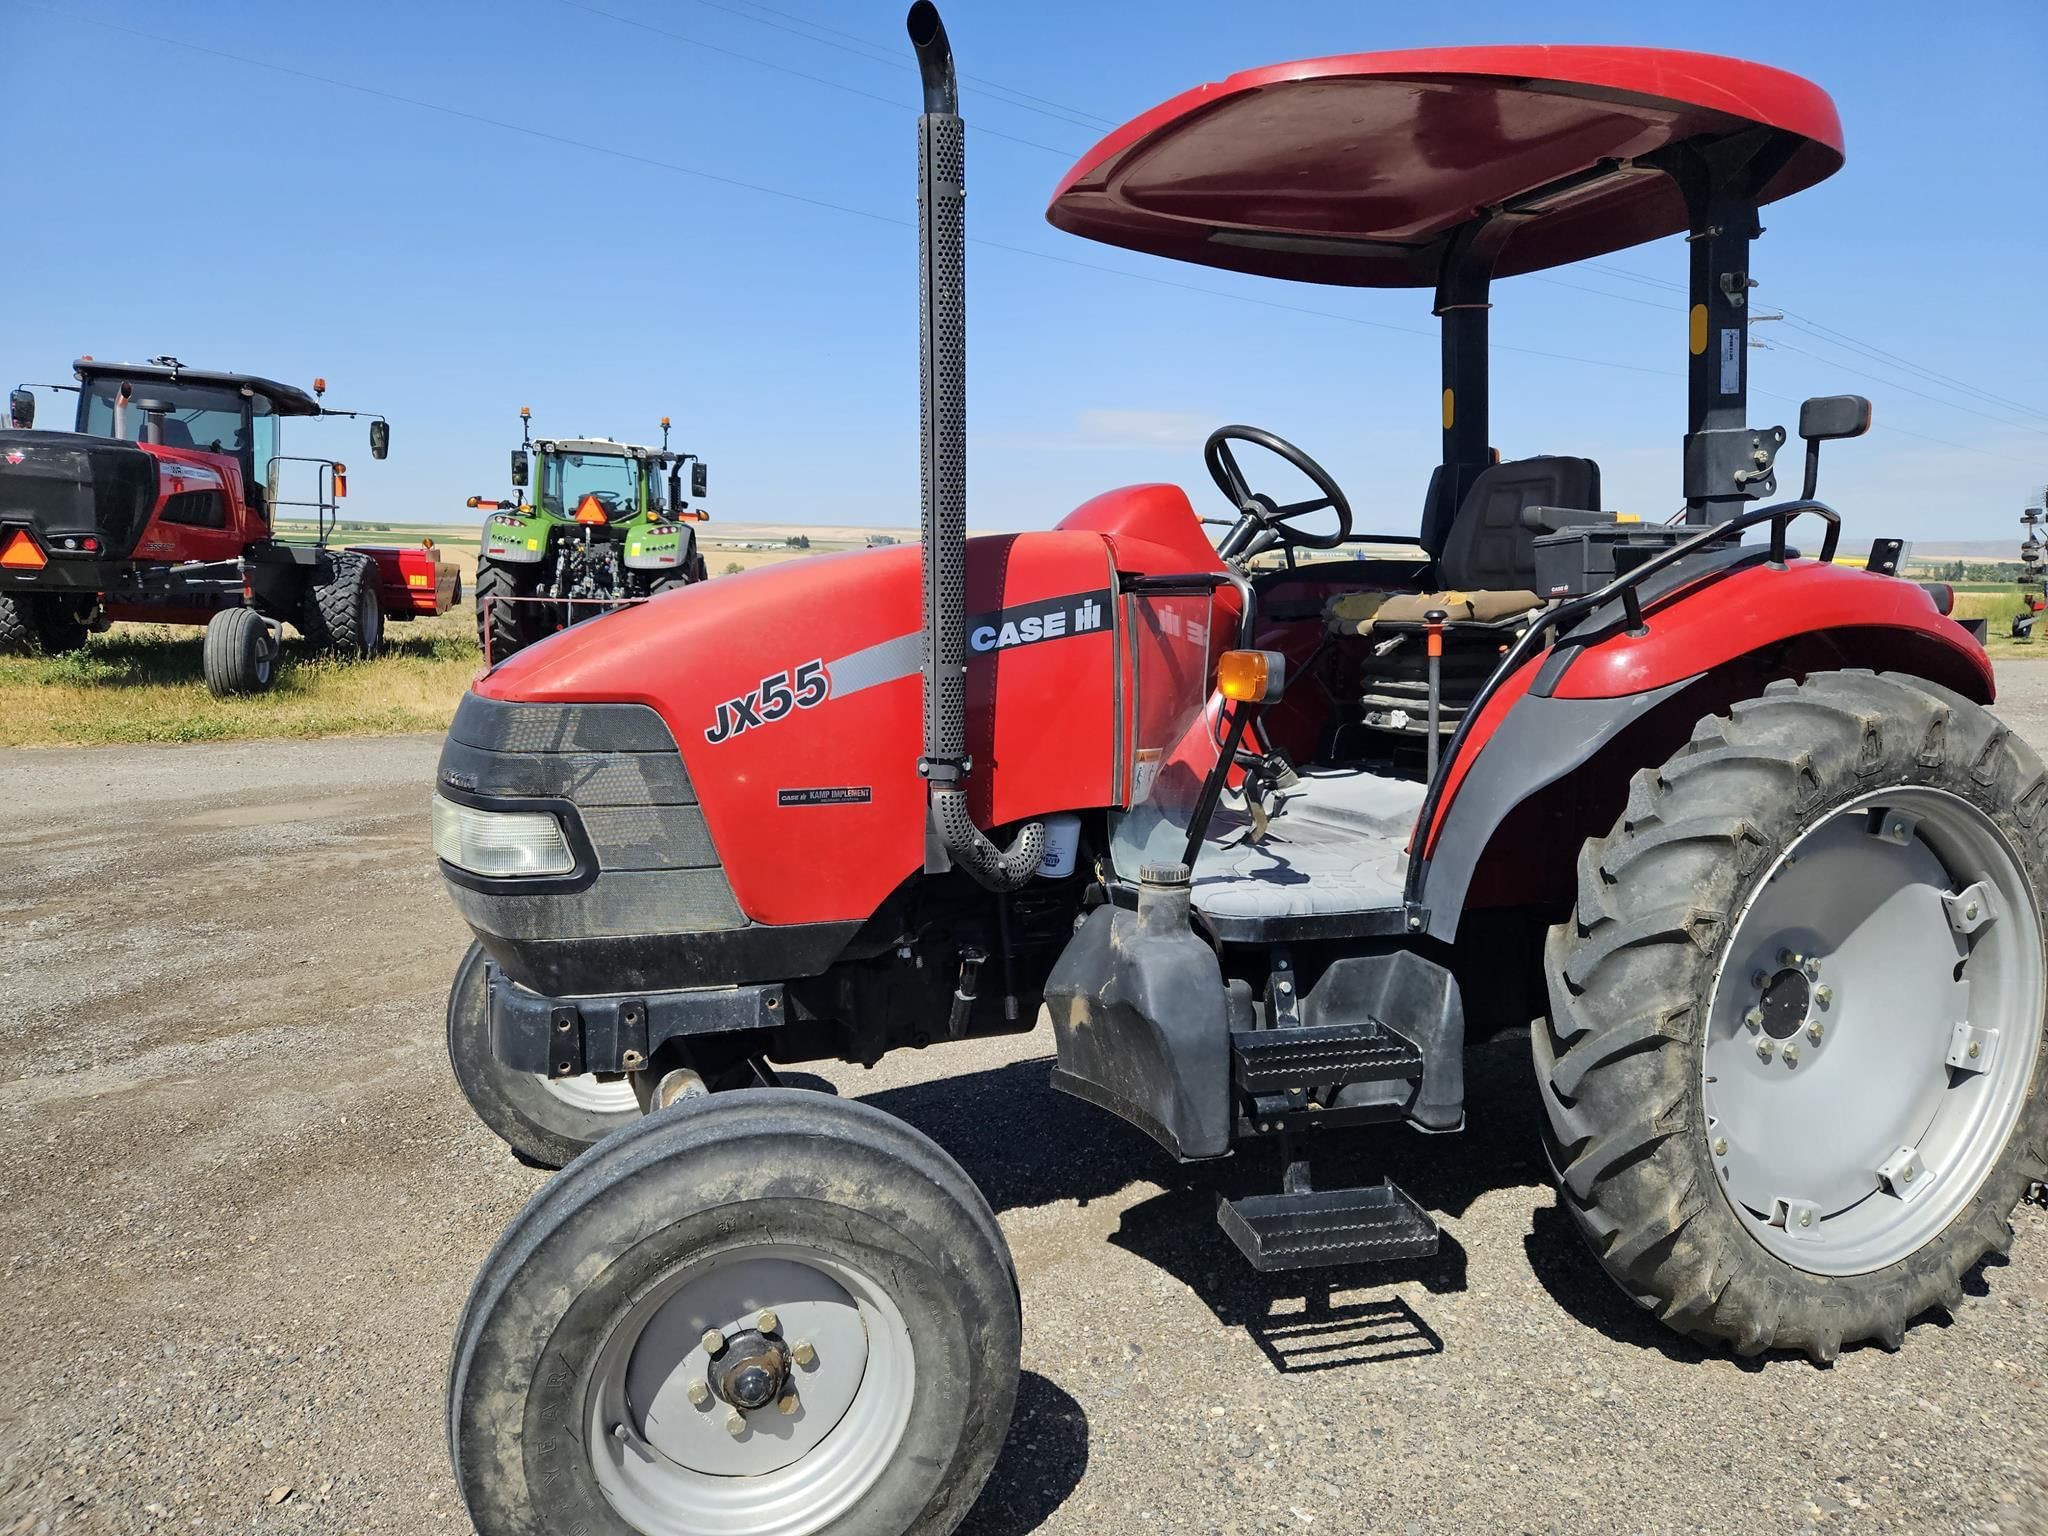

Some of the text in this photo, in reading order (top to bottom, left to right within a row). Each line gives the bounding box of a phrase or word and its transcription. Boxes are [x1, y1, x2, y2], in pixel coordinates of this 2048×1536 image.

[970, 611, 1066, 652] CASE
[704, 657, 828, 744] JX55
[809, 791, 830, 799] KAMP
[831, 789, 870, 798] IMPLEMENT
